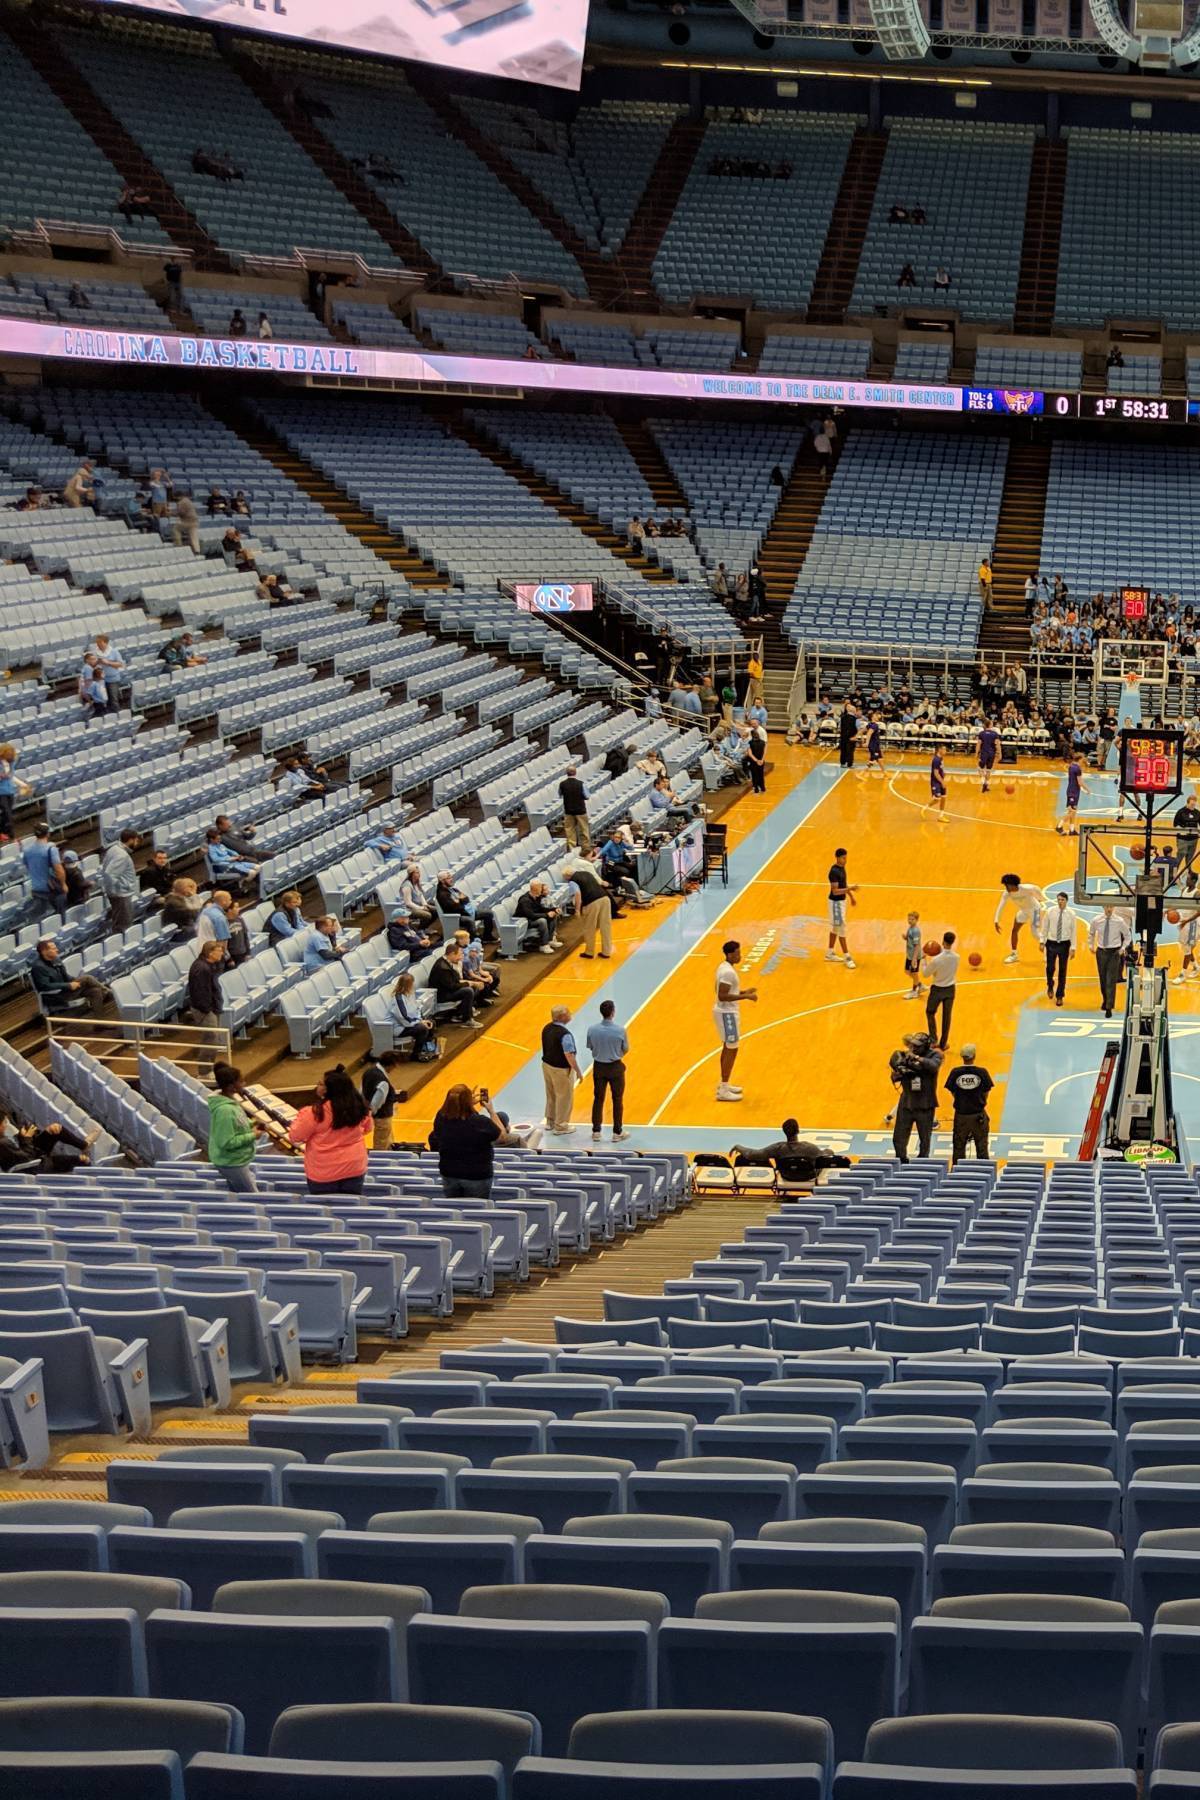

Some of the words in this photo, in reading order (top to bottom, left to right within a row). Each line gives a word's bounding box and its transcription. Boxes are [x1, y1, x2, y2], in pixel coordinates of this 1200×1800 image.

[64, 329, 168, 362] CAROLINA
[180, 338, 358, 374] BASKETBALL
[703, 379, 762, 396] WELCOME
[767, 382, 781, 397] TO
[786, 383, 809, 398] THE
[812, 384, 844, 400] DEAN
[865, 388, 905, 403] SMITH
[908, 390, 956, 406] CENTER
[968, 391, 986, 400] TOL:
[968, 400, 986, 409] FLS:
[986, 401, 993, 410] 0
[1056, 396, 1069, 415] 0
[1095, 399, 1117, 415] 1ST
[1122, 400, 1169, 419] 58:31
[1124, 591, 1146, 600] 58:31
[1126, 600, 1143, 616] 30
[1131, 738, 1174, 756] 58:31
